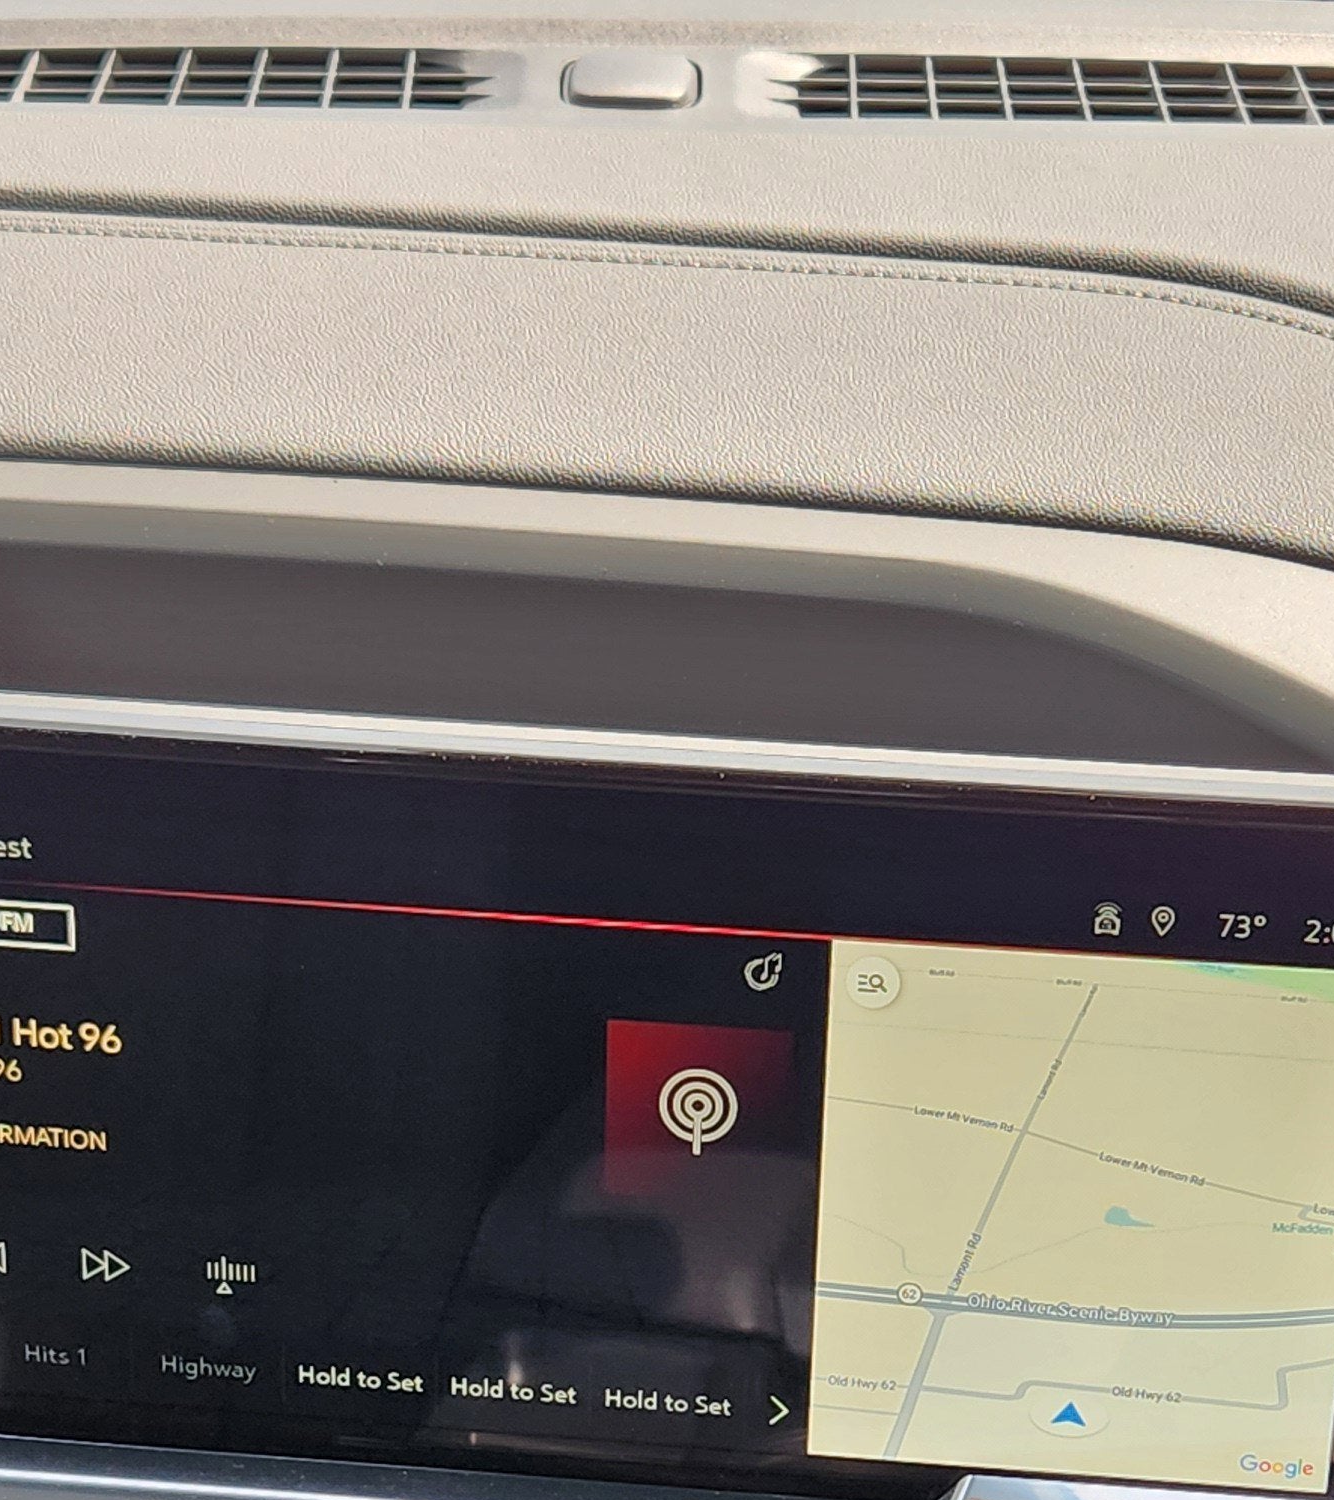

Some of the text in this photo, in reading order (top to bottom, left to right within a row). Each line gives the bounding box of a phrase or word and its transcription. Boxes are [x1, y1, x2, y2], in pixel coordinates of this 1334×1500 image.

[1219, 913, 1267, 939] 73°
[12, 1017, 74, 1050] Hot
[78, 1021, 123, 1055] 96
[914, 1105, 1015, 1133] Lower Mt Vernon Rd
[1099, 1151, 1206, 1187] Lower Mt Vernon Rd
[948, 1233, 982, 1292] Lamont Rd
[902, 1288, 917, 1300] 62
[968, 1292, 1174, 1328] Ohio River Scenic Byway
[24, 1343, 88, 1366] Hits 1
[160, 1354, 258, 1385] Highway
[298, 1364, 424, 1393] Hold to Set
[827, 1375, 897, 1392] Old Hwy 62
[451, 1376, 577, 1405] Hold to Set
[604, 1388, 731, 1417] Hold to Set
[1112, 1386, 1182, 1403] Old Hwy 62
[1240, 1454, 1314, 1479] Google
